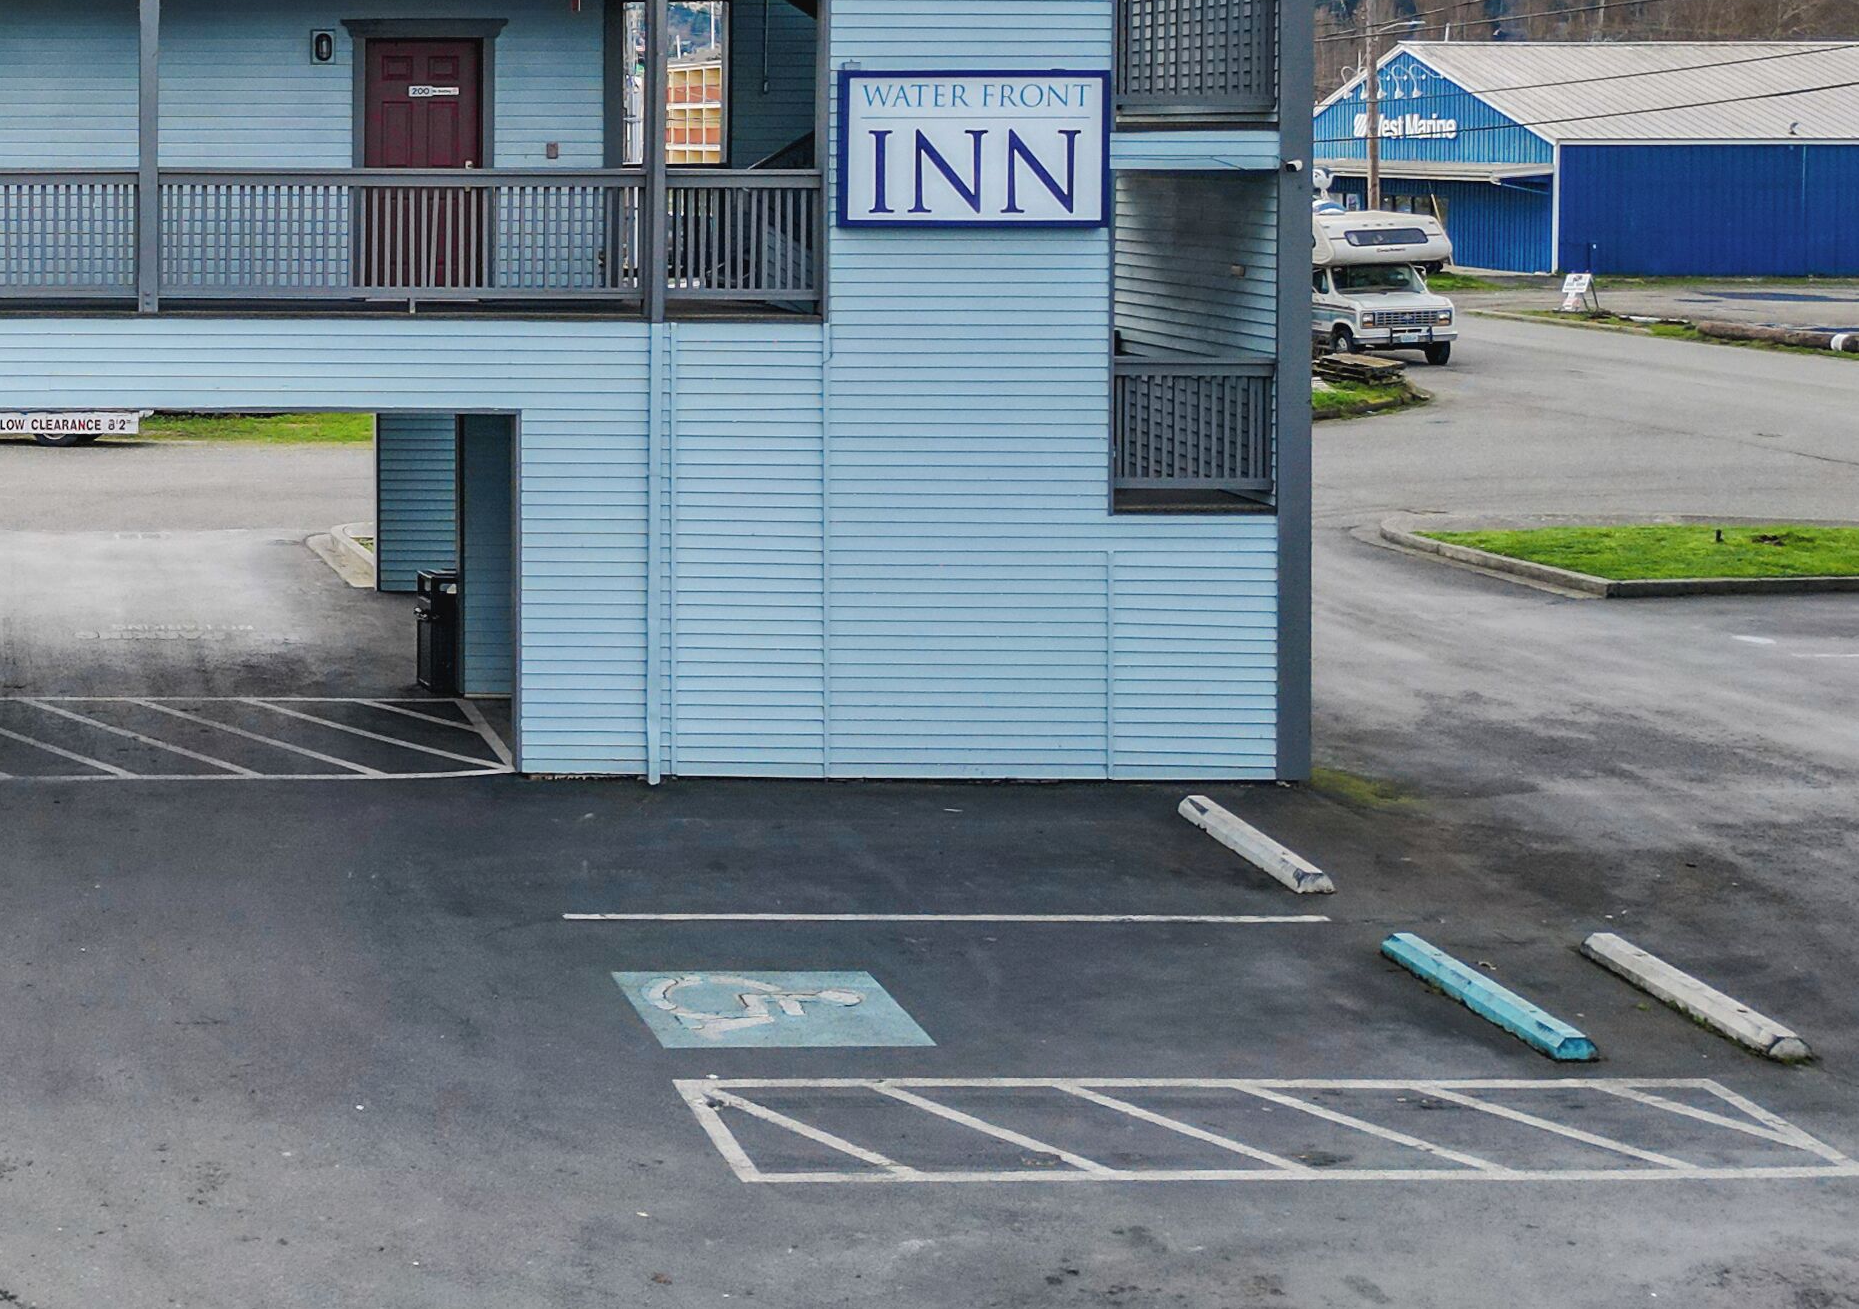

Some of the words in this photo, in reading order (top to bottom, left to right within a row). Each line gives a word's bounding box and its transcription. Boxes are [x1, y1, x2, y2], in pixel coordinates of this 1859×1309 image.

[411, 87, 430, 95] 200
[862, 84, 973, 108] WATER
[981, 83, 1093, 108] FRONT
[1405, 112, 1458, 140] Marine
[868, 127, 1082, 214] INN
[0, 419, 26, 431] LOW
[31, 419, 102, 432] CLEARANCE
